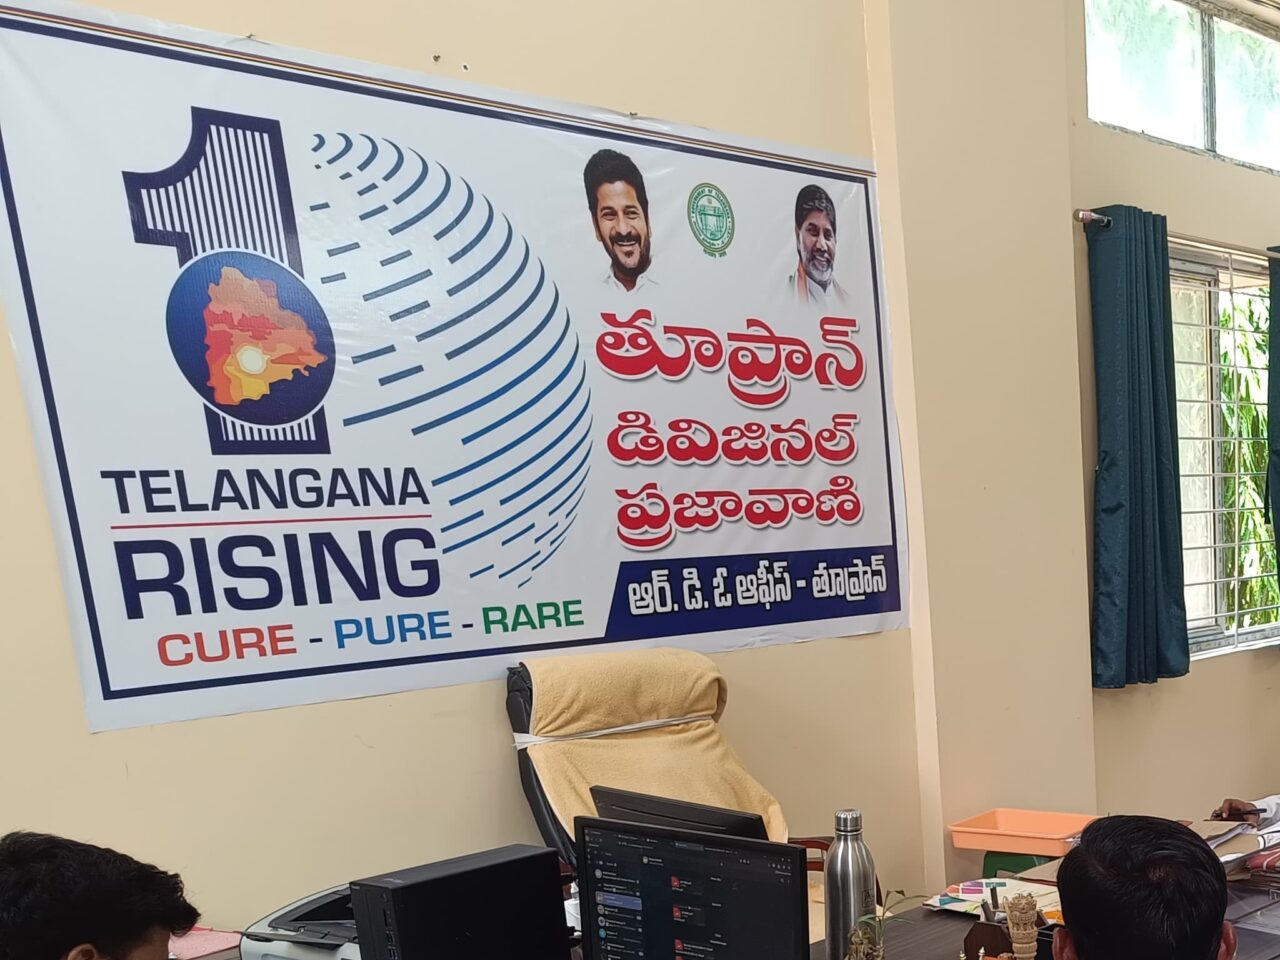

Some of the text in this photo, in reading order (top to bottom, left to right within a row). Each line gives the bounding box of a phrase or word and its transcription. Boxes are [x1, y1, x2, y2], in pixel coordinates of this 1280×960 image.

[595, 308, 865, 407] తూప్రాన్
[606, 410, 859, 464] డివిజినల్
[100, 466, 431, 514] TELANGANA
[614, 475, 864, 551] ప్రజావాణి
[112, 527, 442, 620] RISING
[627, 569, 679, 615] ఆర్.
[682, 567, 709, 610] డి.
[735, 559, 792, 610] ఆఫీస్
[811, 554, 887, 601] తూప్రాన్
[157, 624, 297, 667] CURE
[334, 610, 453, 649] PURE
[482, 599, 585, 635] RARE
